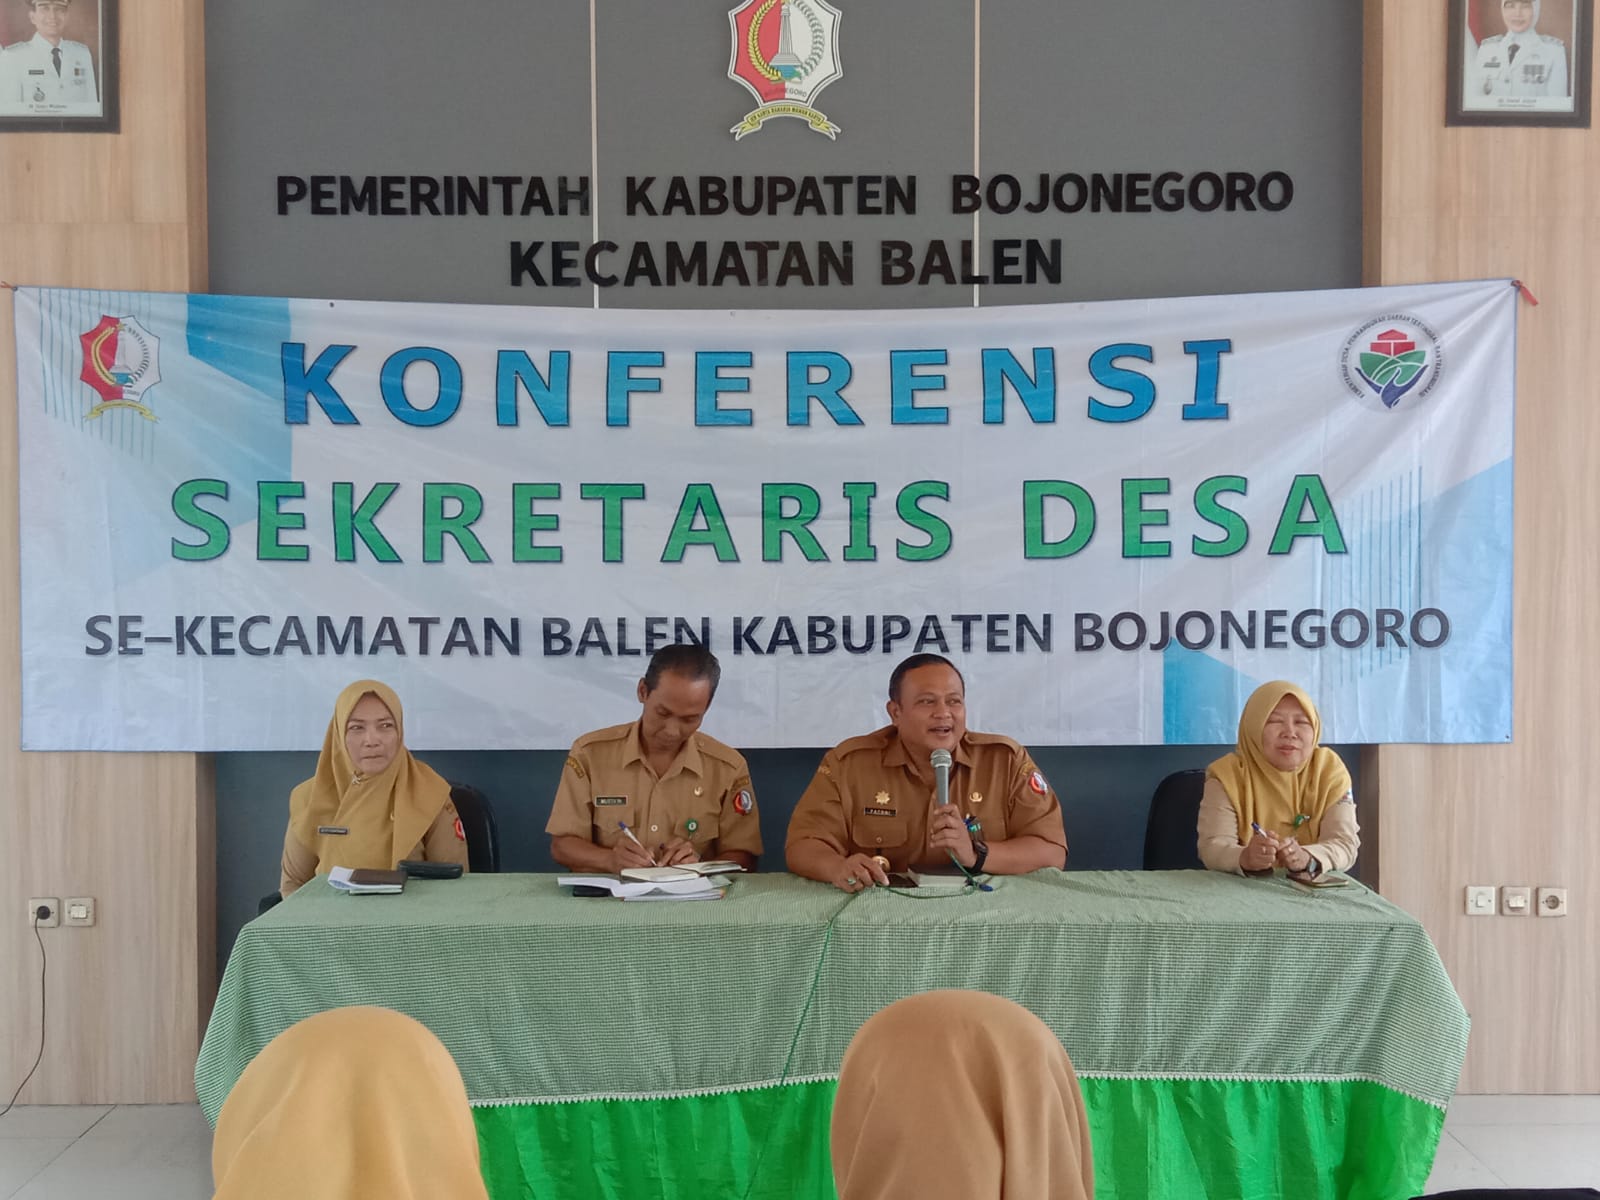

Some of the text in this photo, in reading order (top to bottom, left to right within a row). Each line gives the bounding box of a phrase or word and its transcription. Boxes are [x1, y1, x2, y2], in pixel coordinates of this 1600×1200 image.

[276, 171, 1294, 216] PEMERINTAH KABUPATEN BOJONEGORO
[509, 238, 1062, 288] KECAMATAN BALEN
[281, 339, 1231, 427] KONFERENSI
[170, 474, 1350, 564] SEKRETARIS DESA
[542, 616, 711, 656] BALEN
[732, 613, 1053, 656] KABUPATEN
[1074, 607, 1451, 652] BOJONEGORO
